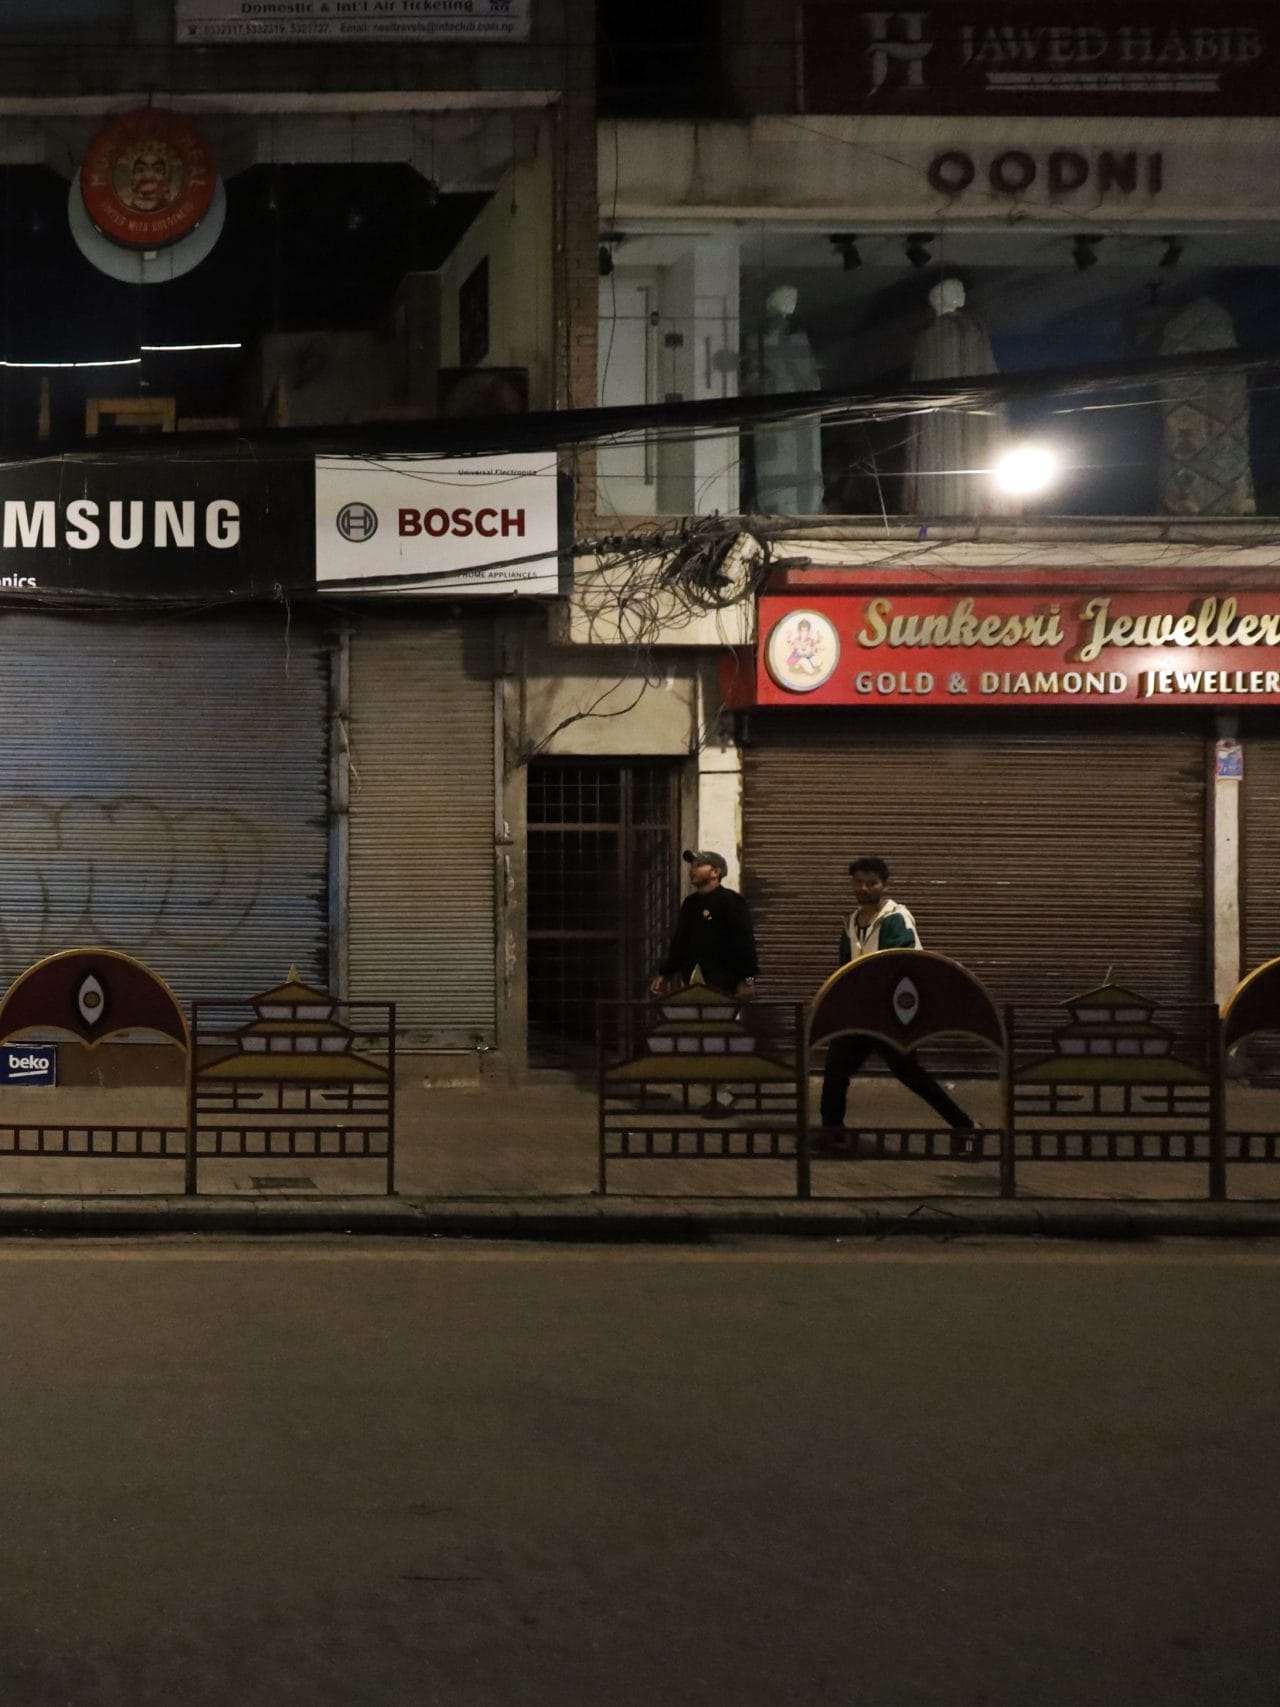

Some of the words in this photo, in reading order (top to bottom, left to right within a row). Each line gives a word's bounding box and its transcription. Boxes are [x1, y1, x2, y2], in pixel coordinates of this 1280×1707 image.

[241, 1, 312, 15] Domestic
[959, 26, 1109, 67] JAWED
[1117, 26, 1266, 65] HABIB
[927, 150, 1163, 197] OODNI
[398, 508, 525, 537] BOSCH
[488, 571, 537, 579] APPLIANCES
[858, 597, 1065, 648] Sunkesri
[1074, 596, 1280, 663] Jeweller
[855, 671, 934, 694] GOLD
[948, 671, 969, 694] &
[980, 671, 1128, 694] DIAMOND
[1144, 670, 1280, 698] JEWELLER
[8, 1054, 49, 1070] beko
